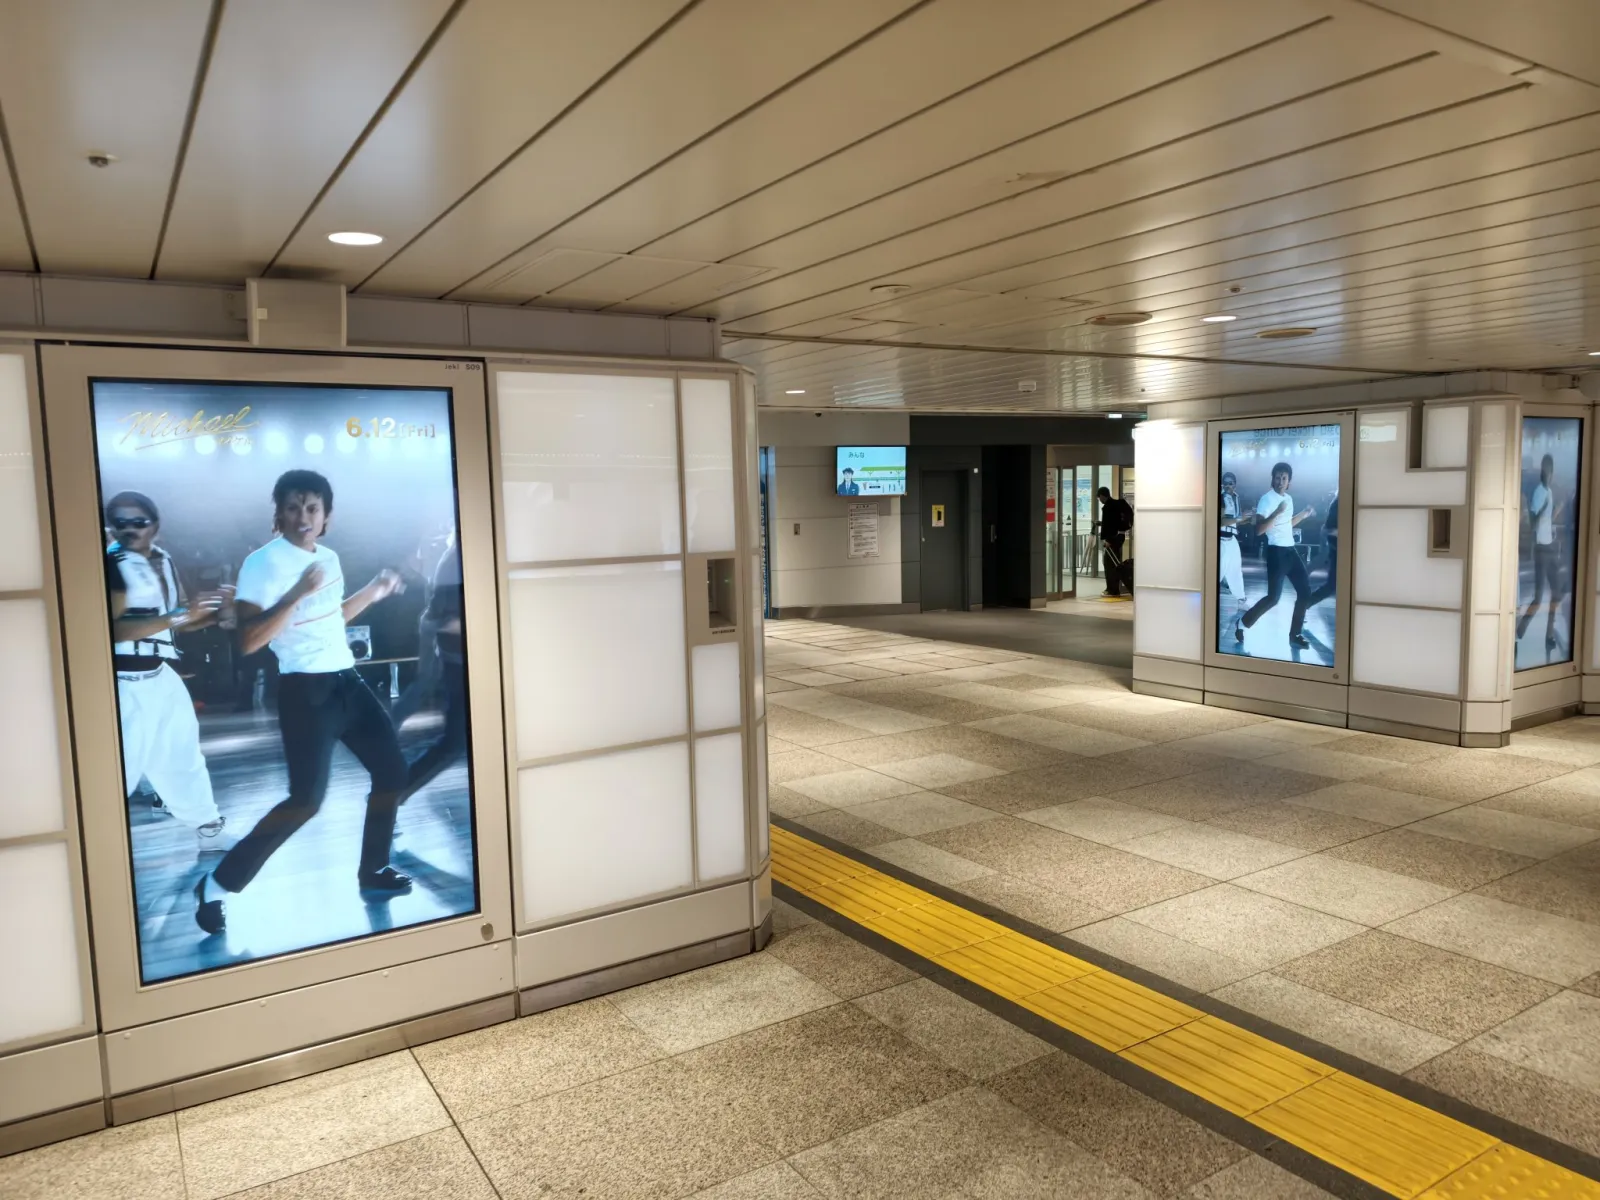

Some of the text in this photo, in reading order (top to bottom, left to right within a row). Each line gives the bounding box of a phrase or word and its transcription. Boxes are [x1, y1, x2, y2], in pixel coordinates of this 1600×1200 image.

[465, 363, 481, 371] S09
[119, 405, 260, 445] Michael
[345, 416, 436, 438] 6.12 [Fri]
